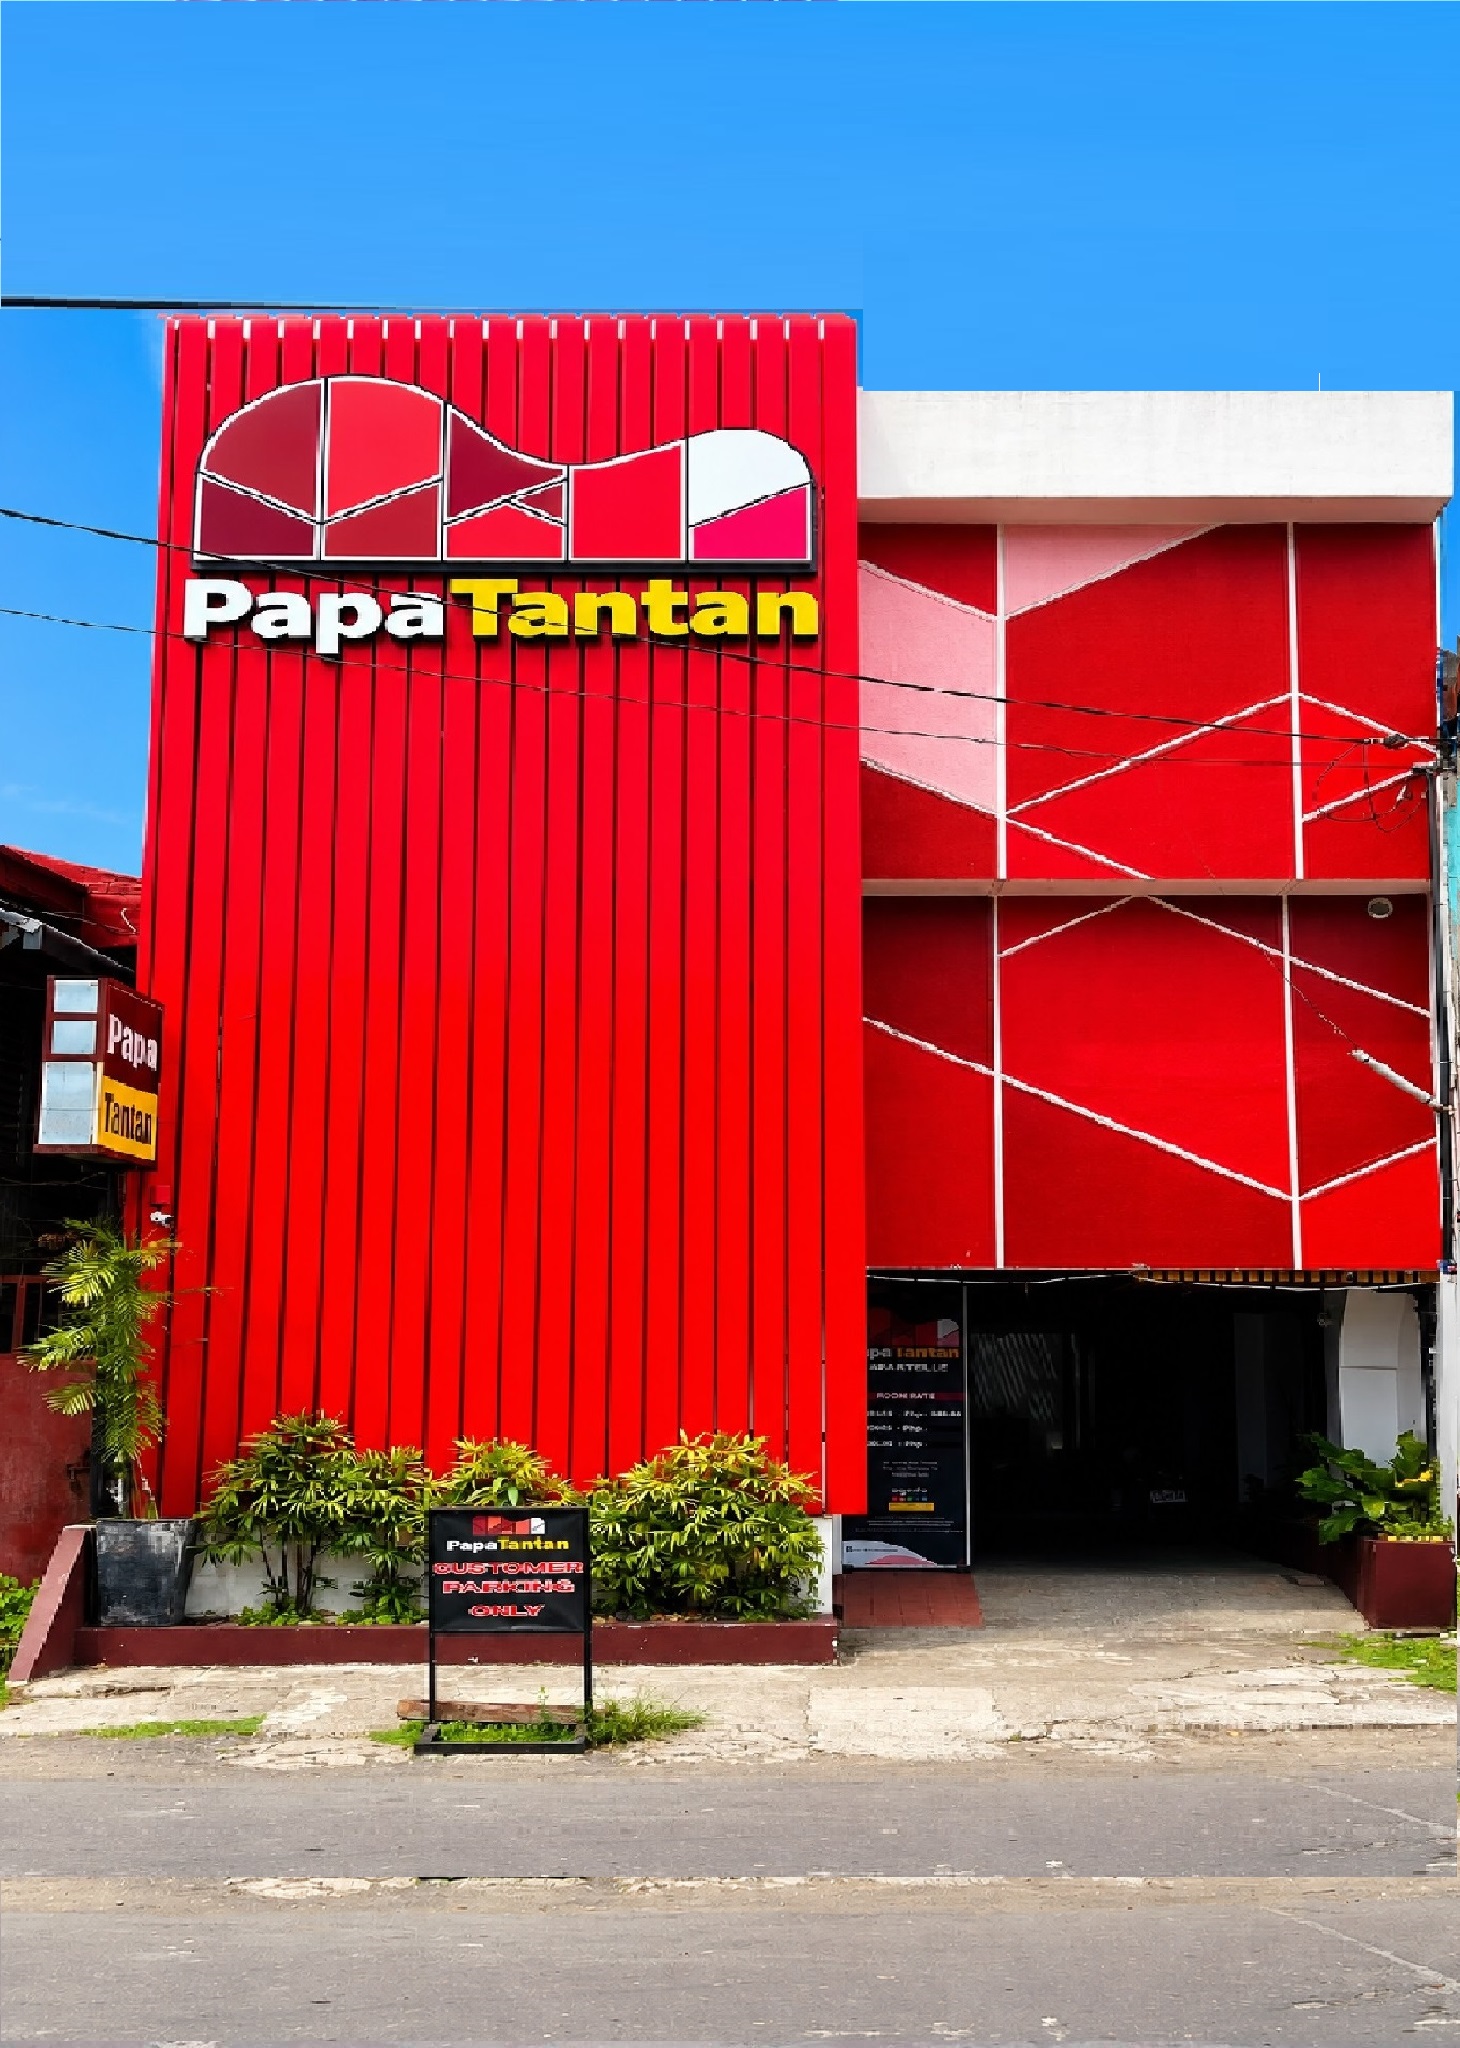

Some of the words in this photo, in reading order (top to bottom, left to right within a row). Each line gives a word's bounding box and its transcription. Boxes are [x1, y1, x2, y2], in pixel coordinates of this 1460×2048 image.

[107, 1013, 157, 1071] Papa
[105, 1092, 152, 1144] Tantan
[433, 1561, 584, 1574] CUSTOMER
[442, 1579, 575, 1594] PARKING
[469, 1604, 545, 1617] ONLY
